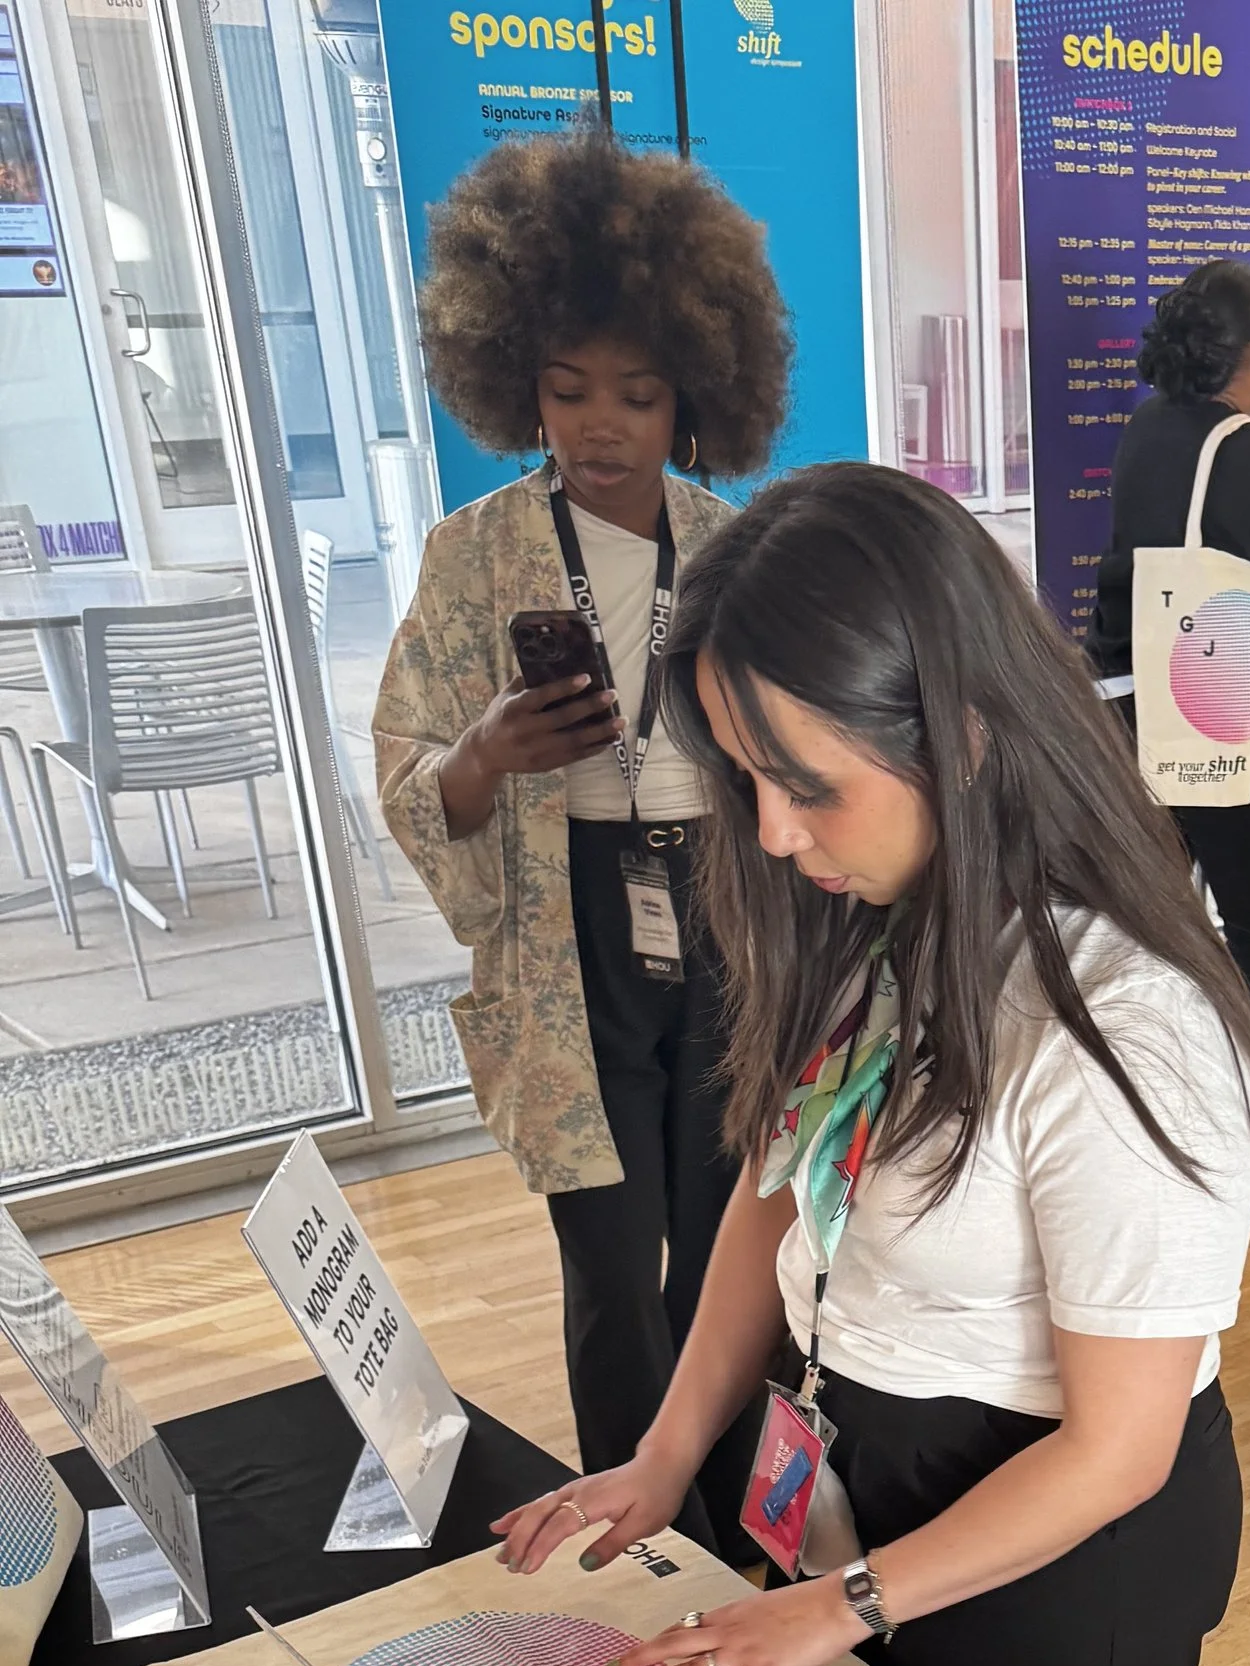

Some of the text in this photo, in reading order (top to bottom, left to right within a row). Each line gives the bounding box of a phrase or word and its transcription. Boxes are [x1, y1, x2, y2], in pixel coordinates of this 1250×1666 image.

[737, 30, 781, 59] shift
[1063, 25, 1223, 77] schedule
[478, 83, 527, 98] ANNUAL
[530, 86, 577, 100] BRONZE
[481, 104, 551, 122] Signature
[1145, 122, 1237, 137] Registration and Social
[59, 524, 70, 556] 4
[68, 521, 121, 556] MATCH
[1161, 591, 1173, 608] T
[1180, 615, 1194, 632] G
[1203, 640, 1215, 657] J
[1157, 756, 1247, 775] get your shift
[1178, 772, 1227, 784] together
[292, 1205, 328, 1269] ADD A
[303, 1223, 360, 1330] MONOGRAM
[333, 1273, 376, 1354] TO YOUR
[354, 1306, 399, 1396] TOTE BAG
[626, 1542, 666, 1568] HO
